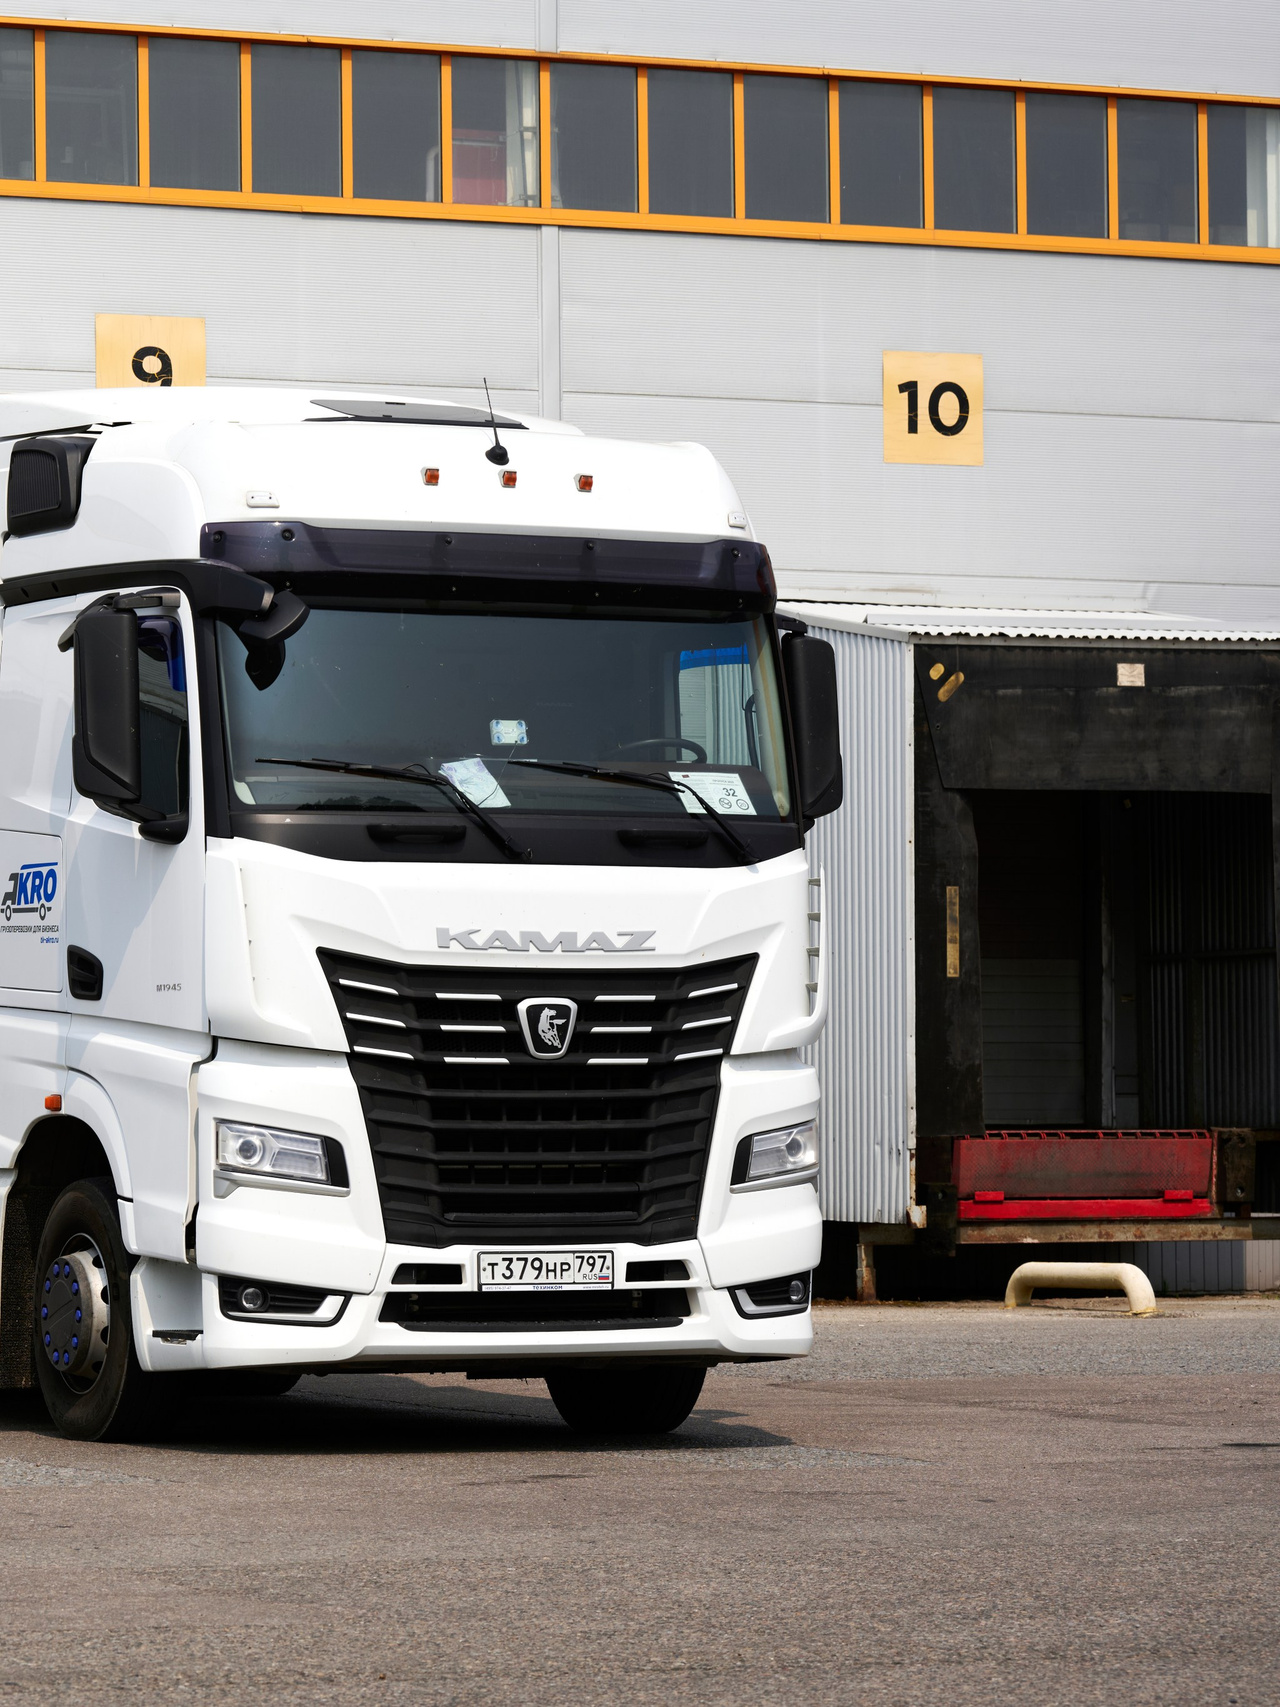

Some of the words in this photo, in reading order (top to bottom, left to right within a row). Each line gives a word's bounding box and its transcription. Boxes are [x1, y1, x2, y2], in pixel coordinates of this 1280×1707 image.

[131, 346, 173, 387] 9
[897, 380, 970, 436] 10
[722, 787, 738, 798] 32
[436, 927, 657, 952] KAMAZ
[575, 1255, 607, 1273] 797
[582, 1273, 598, 1281] RUS
